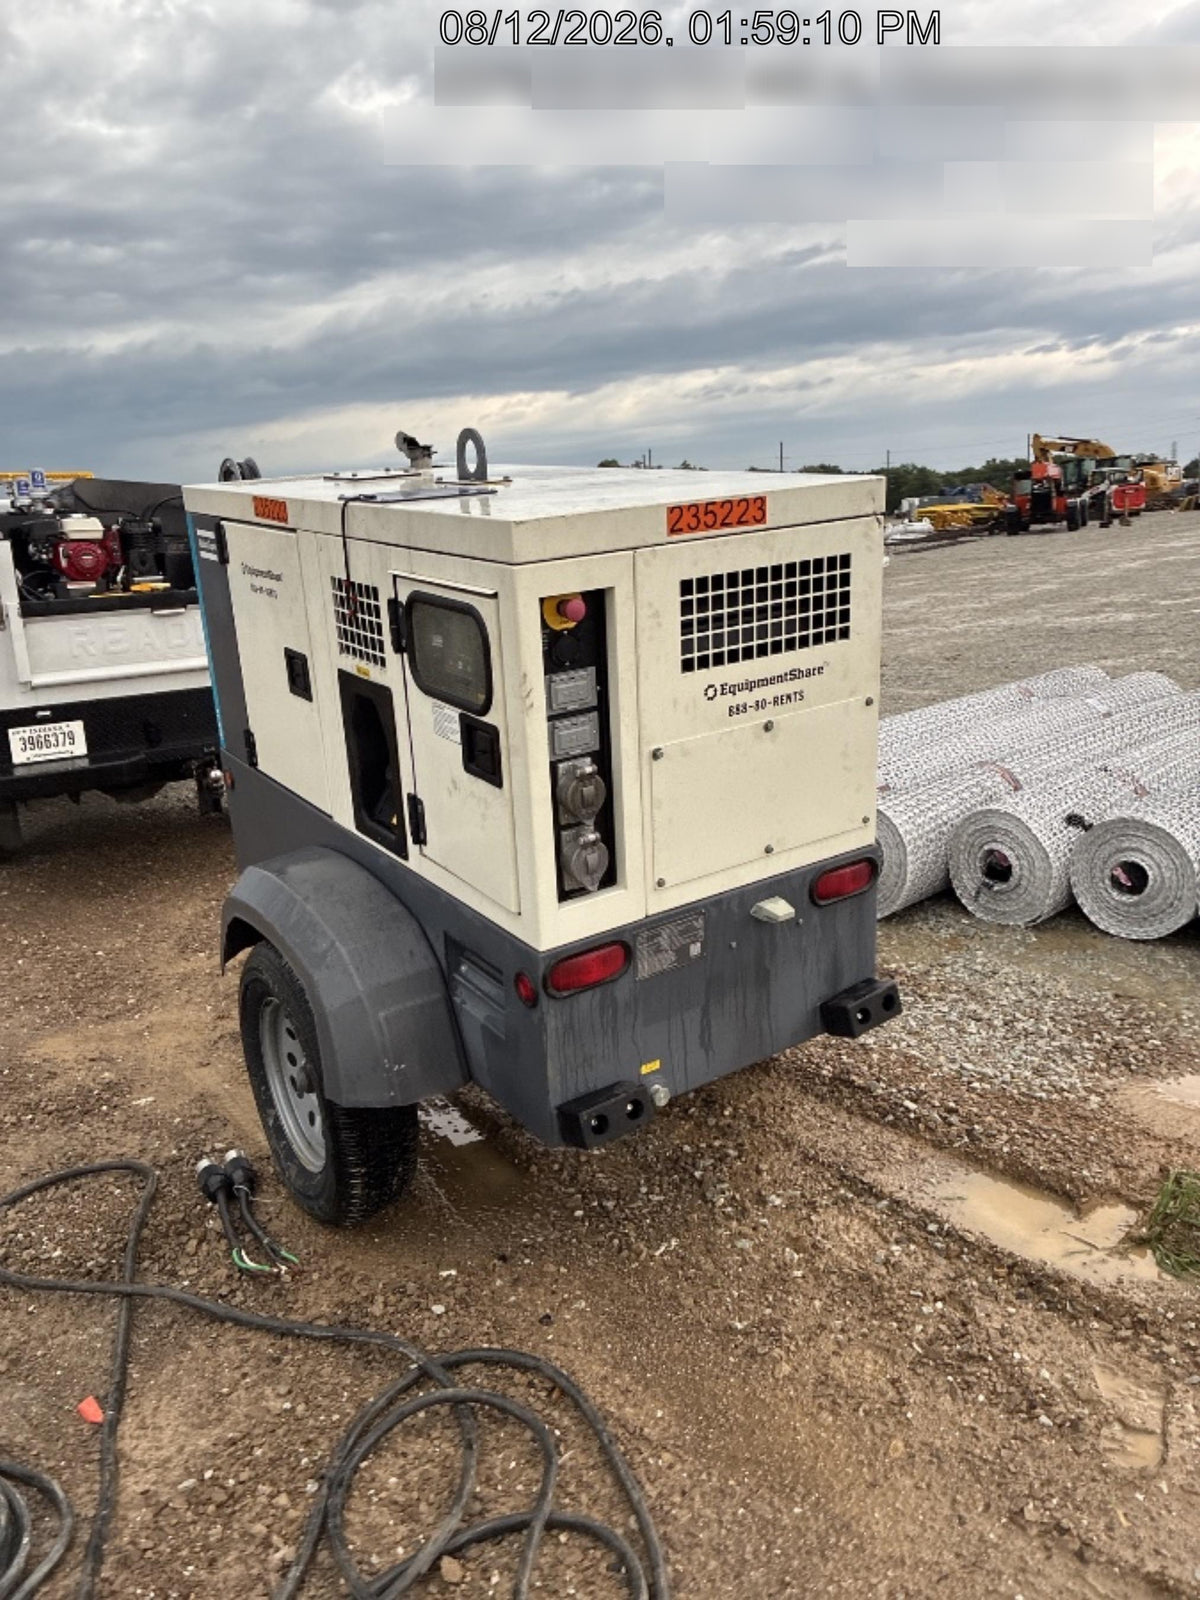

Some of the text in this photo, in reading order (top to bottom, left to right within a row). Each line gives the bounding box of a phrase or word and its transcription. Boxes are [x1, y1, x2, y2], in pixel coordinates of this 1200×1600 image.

[669, 496, 766, 534] 235223
[67, 619, 206, 660] READ
[720, 665, 825, 696] EquipmentShare
[19, 730, 76, 753] 3966379
